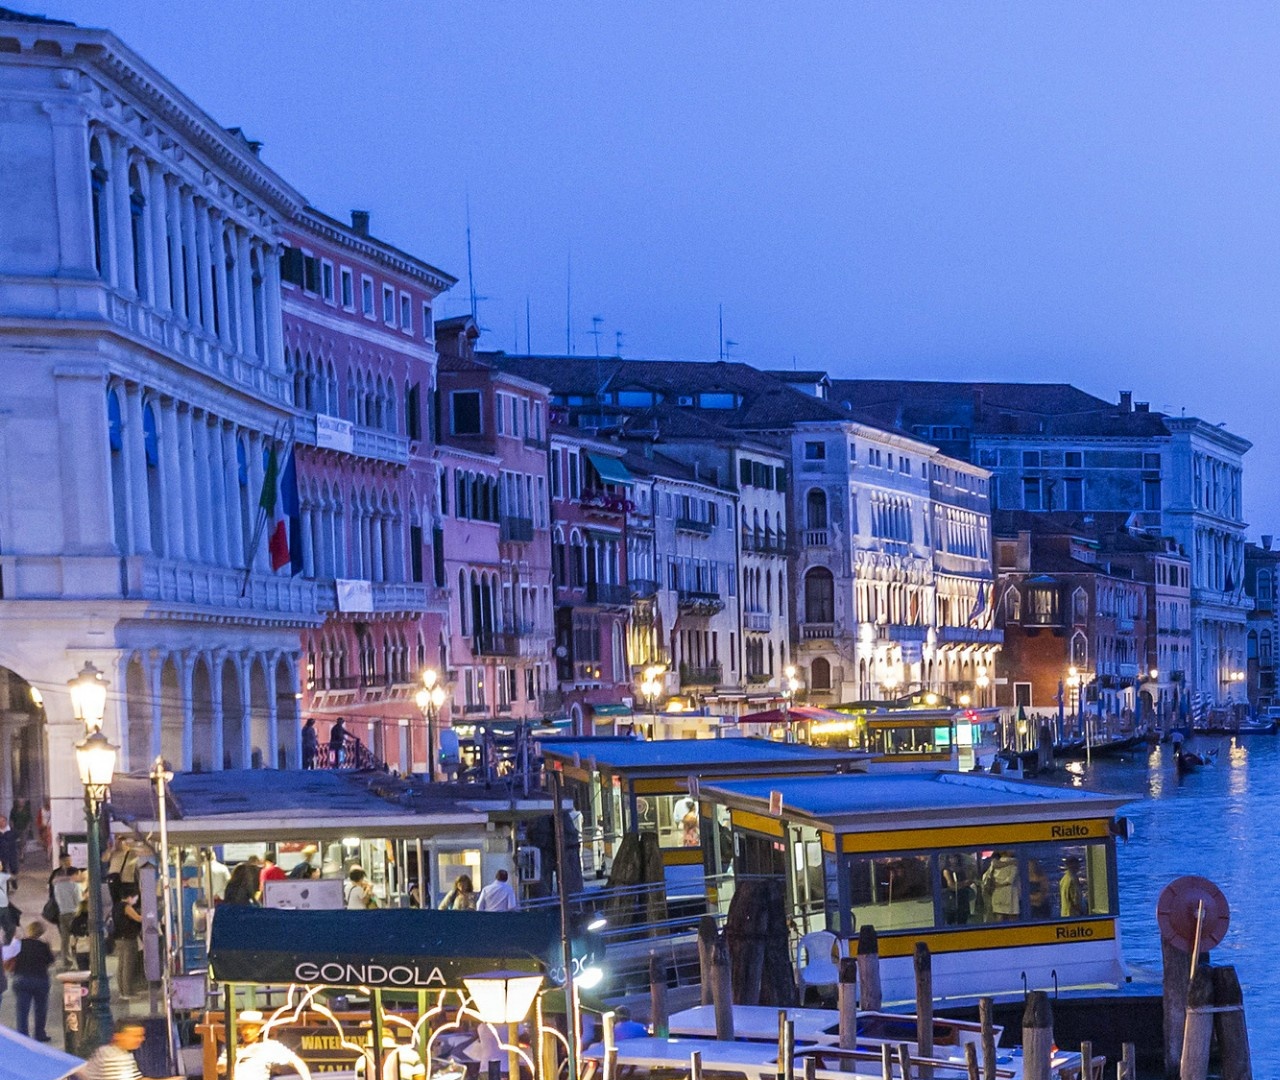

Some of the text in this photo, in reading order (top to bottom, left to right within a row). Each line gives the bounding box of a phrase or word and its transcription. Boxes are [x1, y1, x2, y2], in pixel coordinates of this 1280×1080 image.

[1051, 825, 1089, 837] Rialto
[1056, 926, 1094, 939] Rialto
[295, 962, 447, 986] GONDOLA
